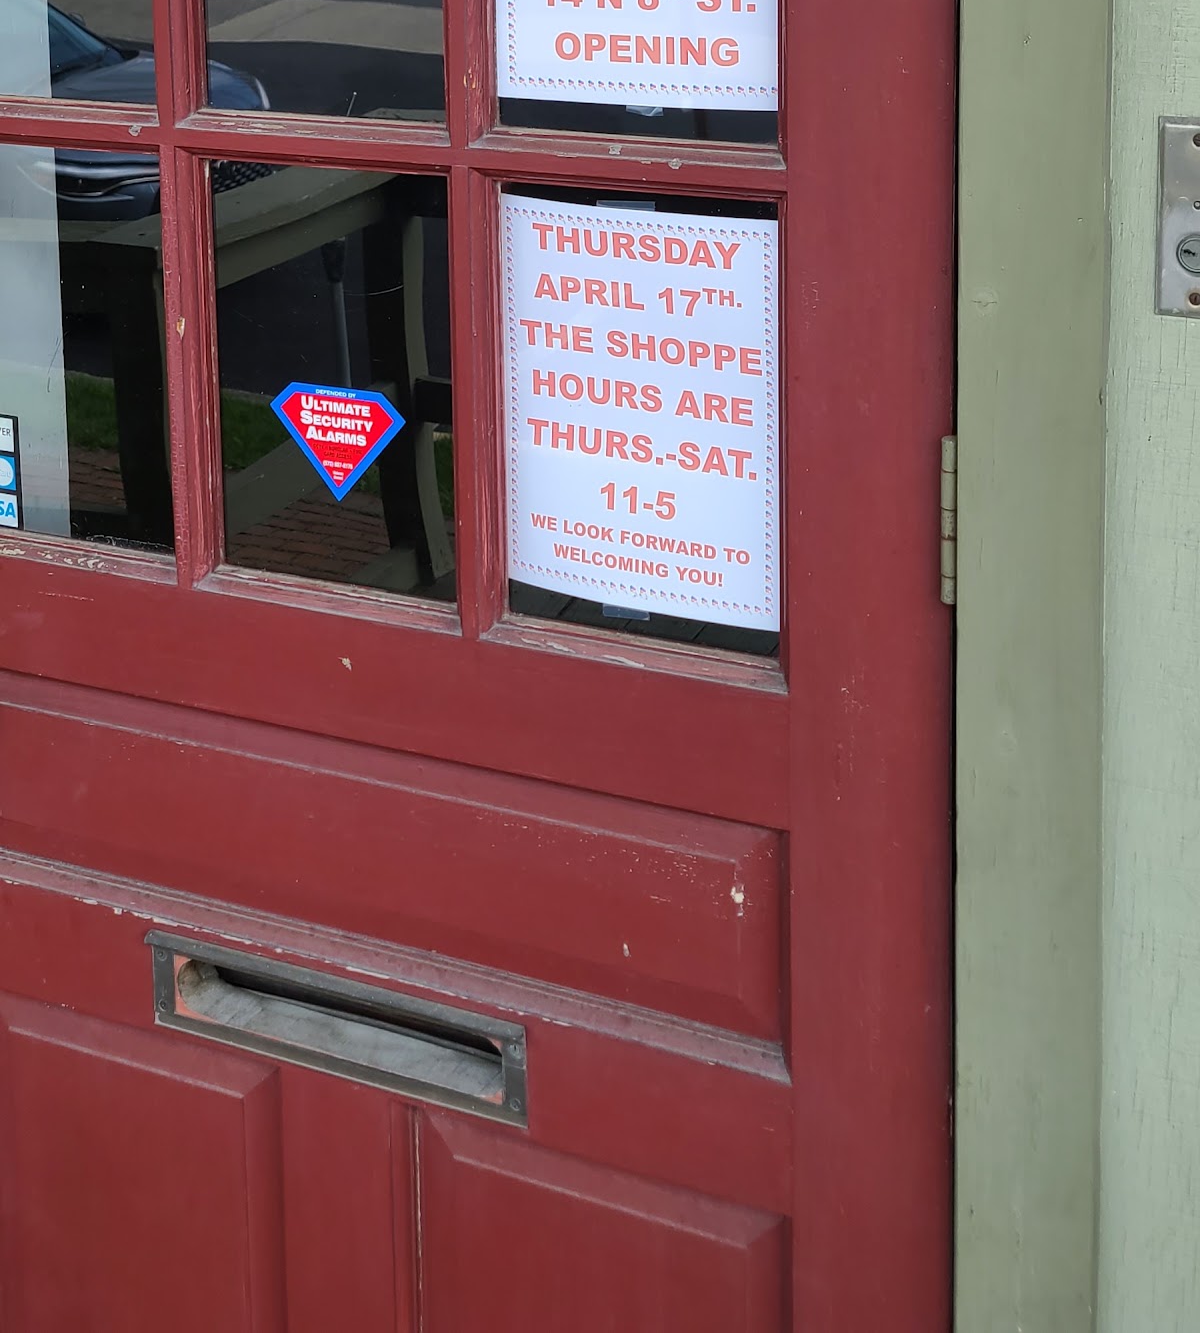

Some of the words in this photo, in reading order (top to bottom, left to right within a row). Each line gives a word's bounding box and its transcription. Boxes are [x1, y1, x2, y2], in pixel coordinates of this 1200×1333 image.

[555, 32, 739, 66] OPENING
[532, 222, 741, 270] THURSDAY
[534, 273, 645, 310] APRIL
[658, 287, 743, 317] 17TH.
[520, 319, 594, 354] THE
[607, 330, 763, 376] SHOPPE
[300, 395, 371, 417] ULTIMATE
[532, 369, 662, 412] HOURS
[675, 390, 754, 426] ARE
[300, 410, 373, 432] SECURITY
[306, 425, 367, 447] ALARMS
[600, 483, 676, 520] 11-5
[531, 513, 557, 532] WE
[564, 520, 614, 543] LOOK
[620, 531, 716, 559] FORWARD
[723, 546, 750, 565] TO
[554, 544, 669, 578] WELCOMING
[675, 565, 724, 587] YOU!
